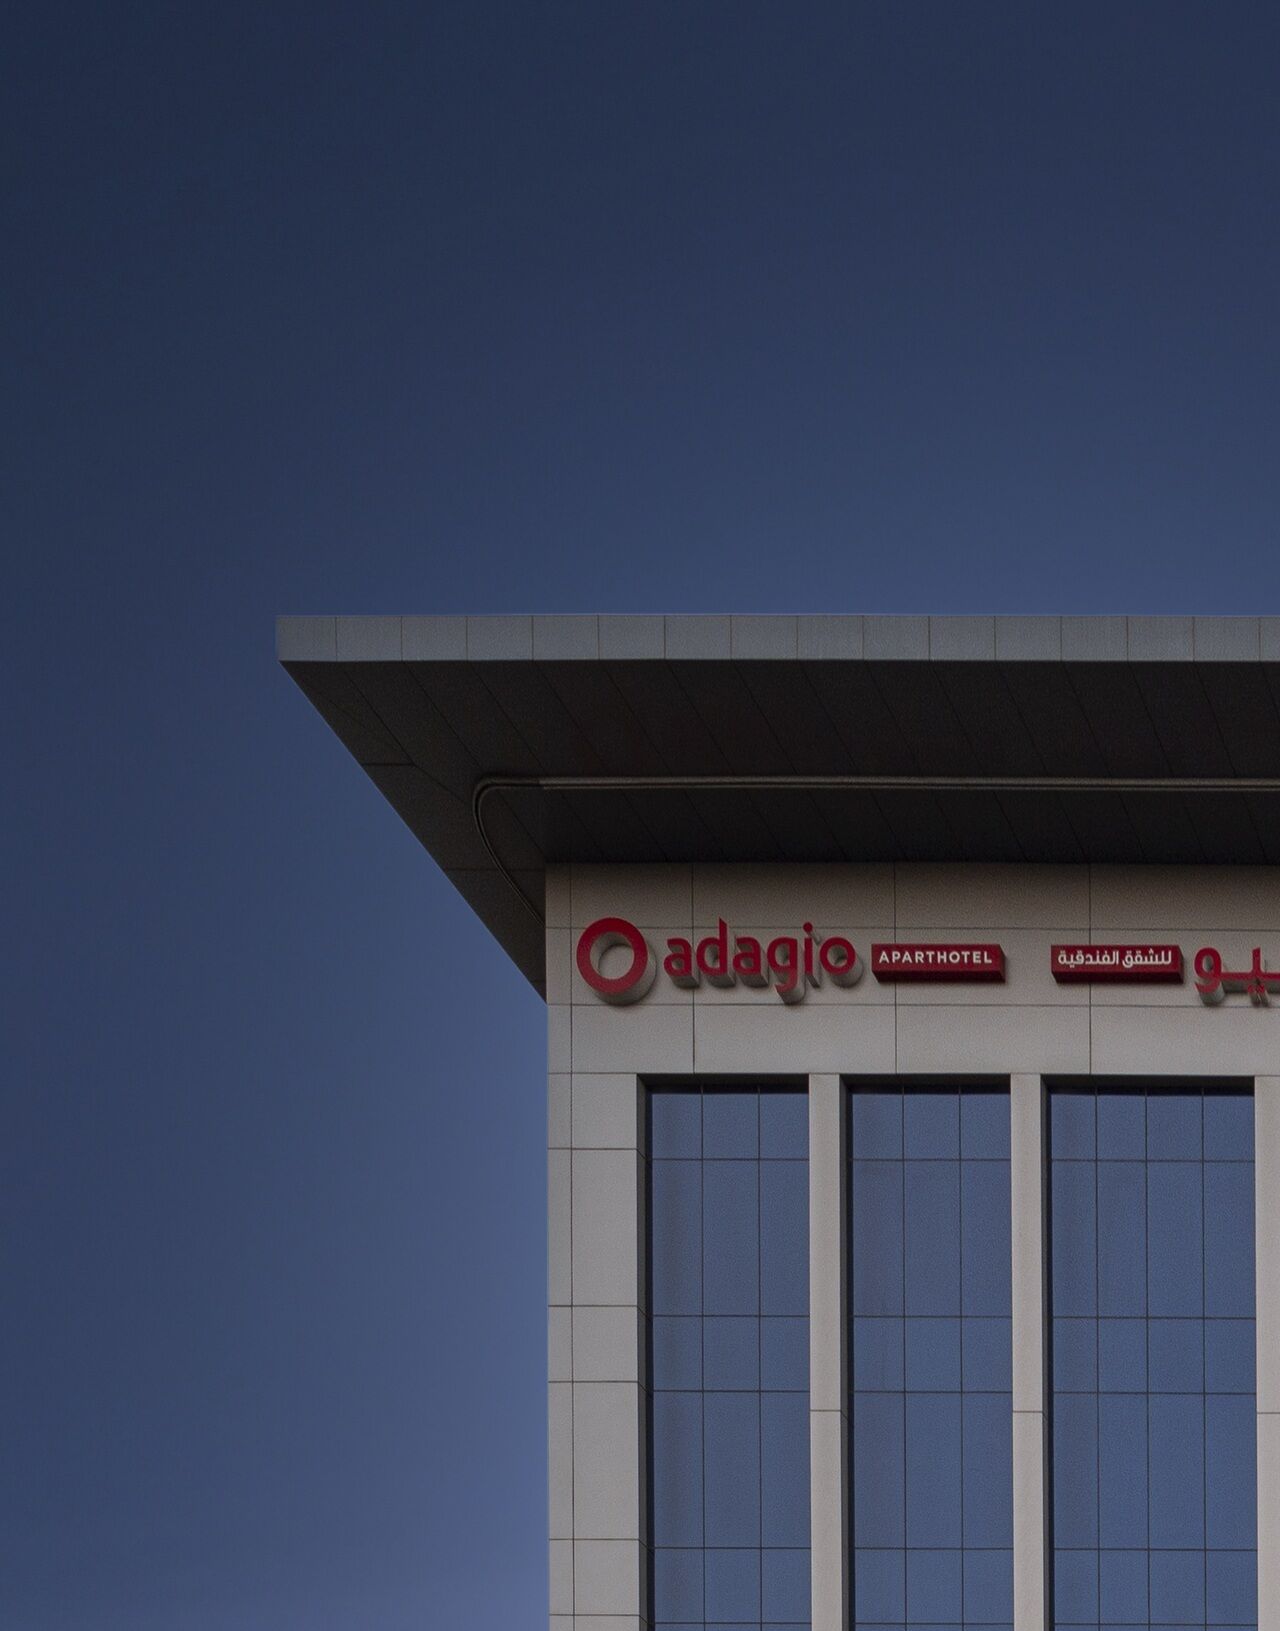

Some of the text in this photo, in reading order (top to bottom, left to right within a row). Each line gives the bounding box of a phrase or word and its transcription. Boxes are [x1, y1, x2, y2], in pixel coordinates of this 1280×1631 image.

[663, 916, 993, 1000] adagio APARTHOTEL
[1057, 949, 1119, 969] الفندقية
[1121, 947, 1172, 969] للشقق
